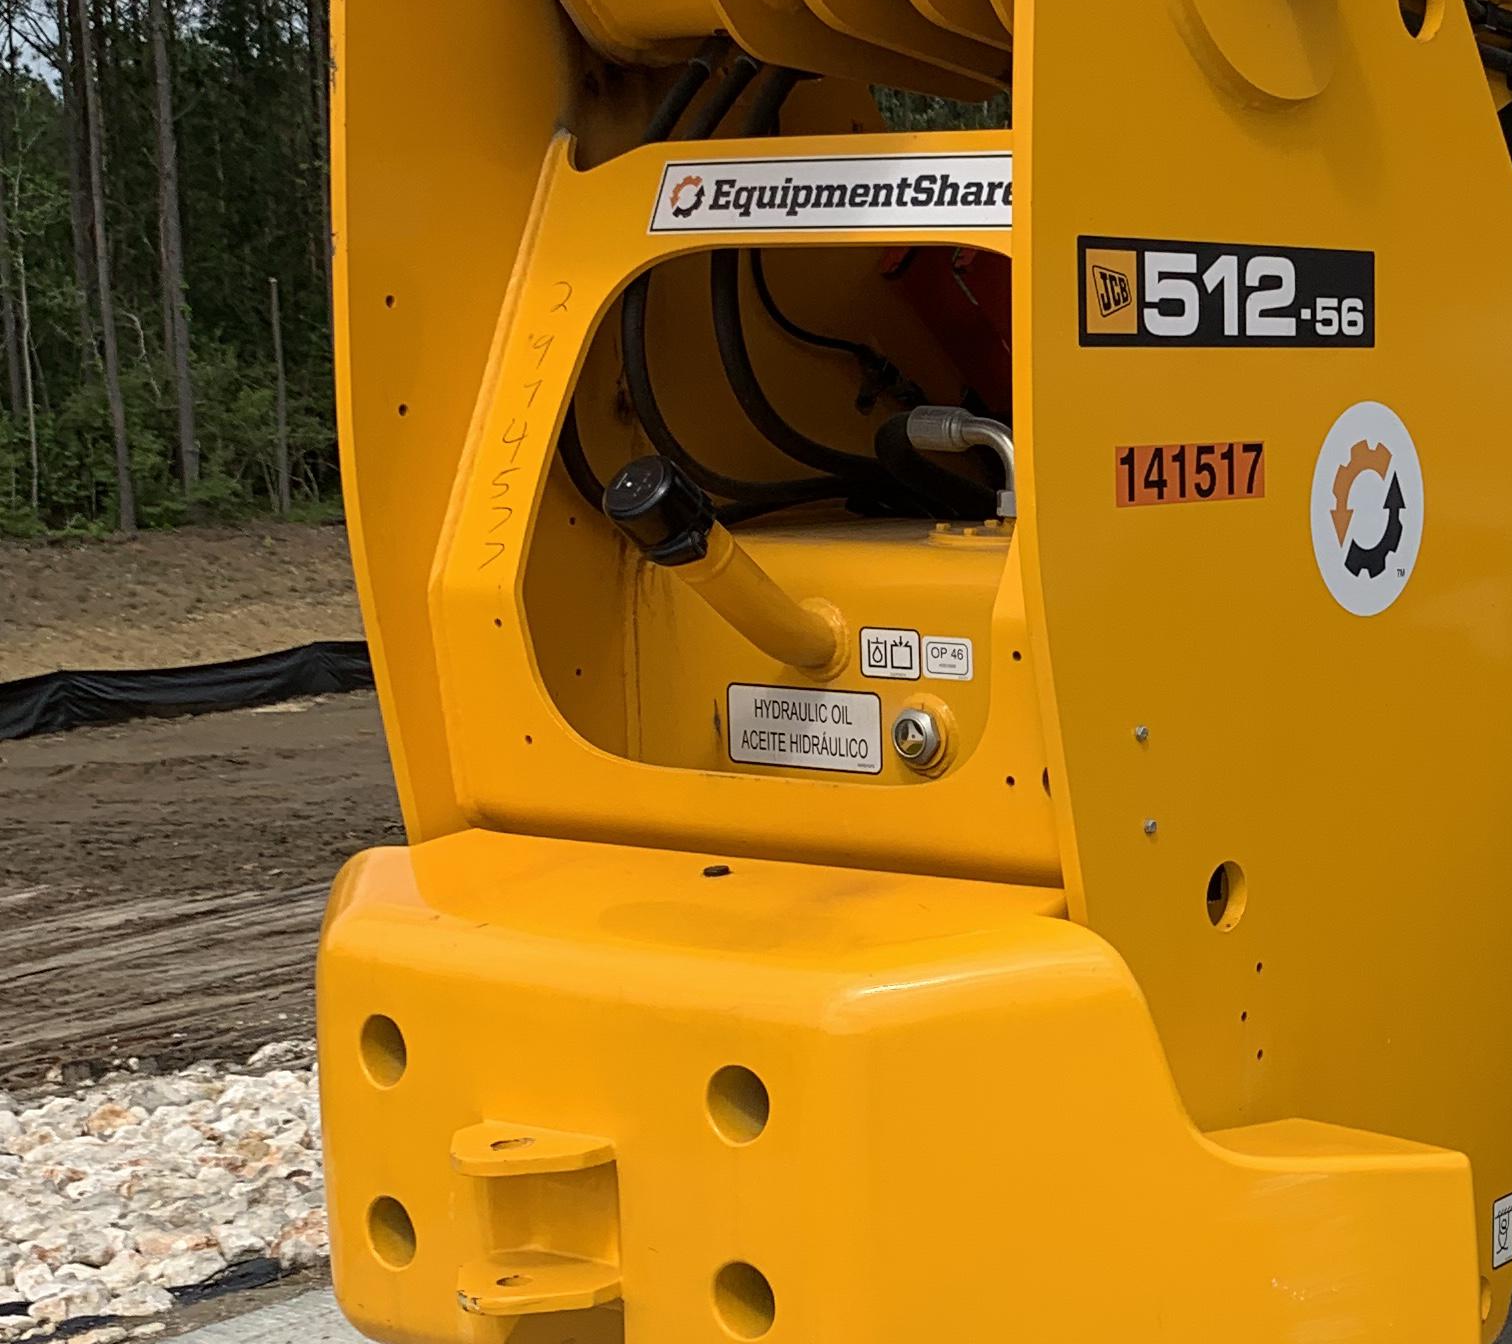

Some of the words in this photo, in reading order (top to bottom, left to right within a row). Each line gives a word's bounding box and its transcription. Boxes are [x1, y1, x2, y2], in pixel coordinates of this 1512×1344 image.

[1099, 271, 1129, 311] JCB
[1119, 443, 1264, 502] 141517
[930, 646, 948, 659] OP
[950, 648, 964, 661] 46
[754, 698, 828, 724] HYDRAULIC
[831, 704, 853, 725] OIL
[741, 729, 786, 753] ACEITE
[789, 731, 868, 759] HIDRÁULICO
